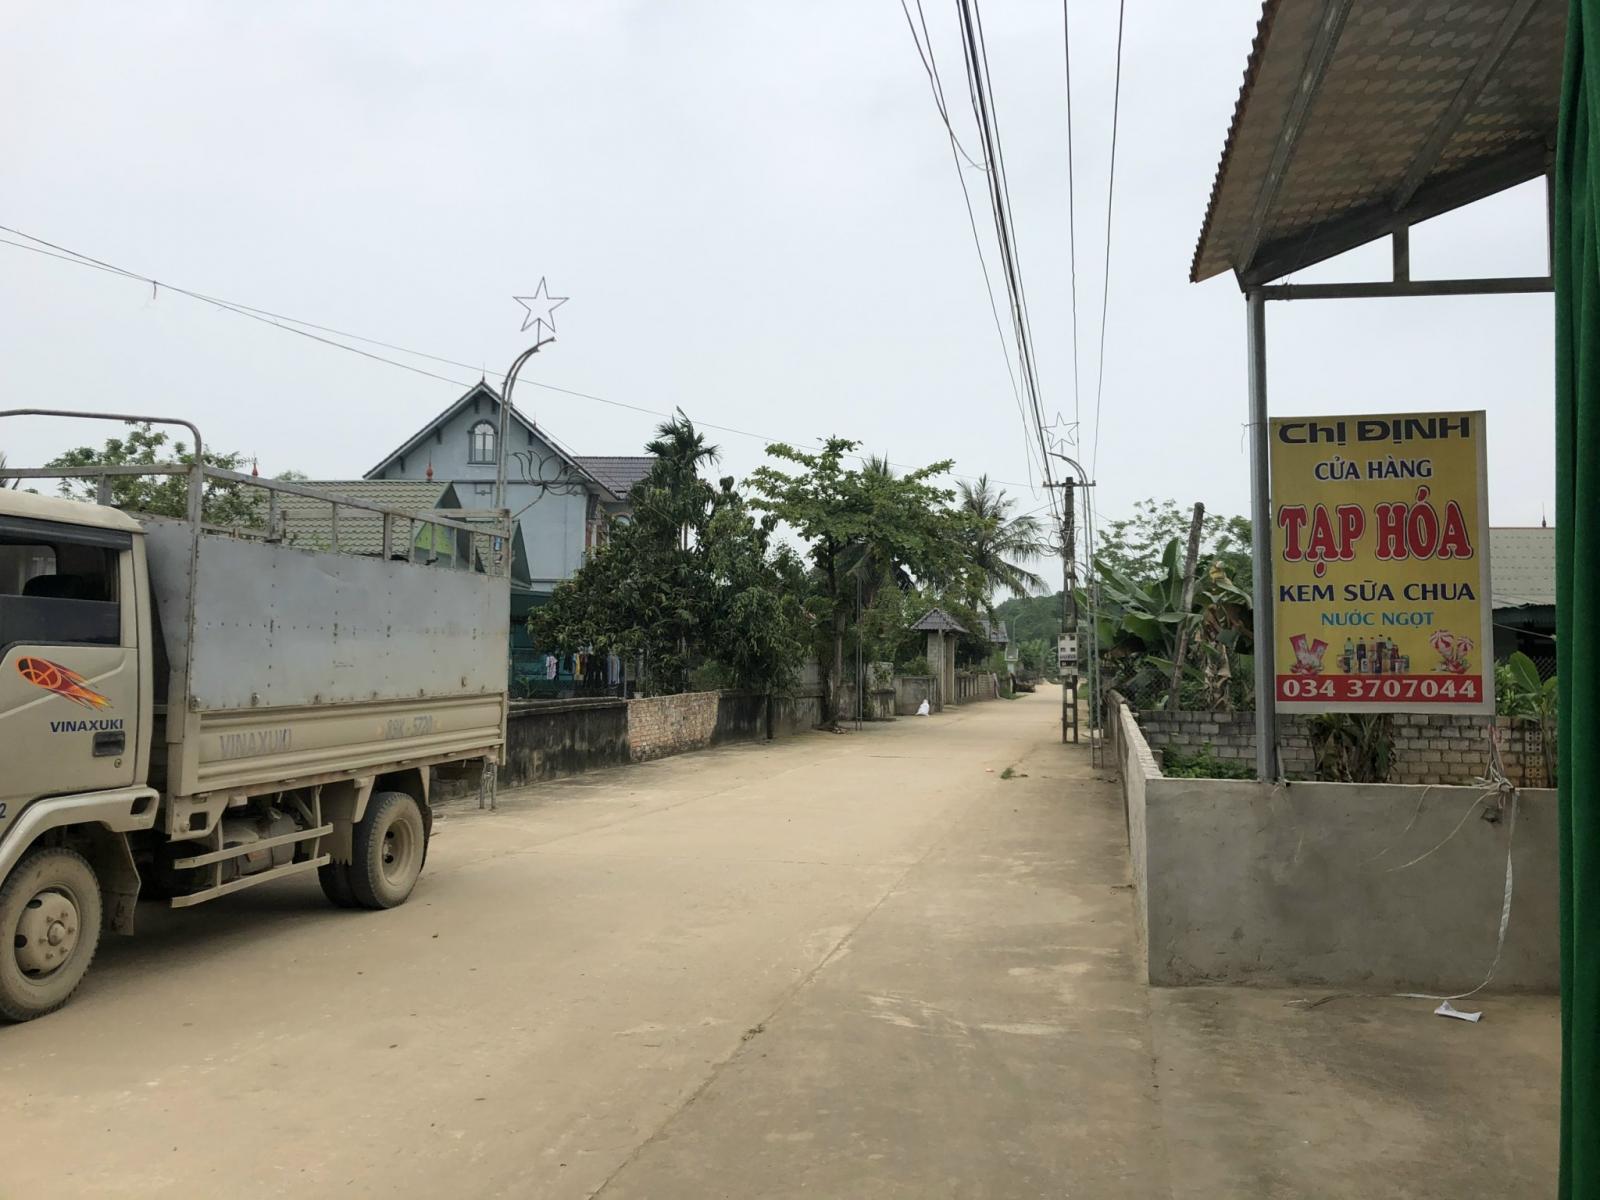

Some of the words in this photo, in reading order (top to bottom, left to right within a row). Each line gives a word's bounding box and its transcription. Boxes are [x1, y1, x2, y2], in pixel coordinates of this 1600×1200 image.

[1357, 416, 1470, 444] ĐỊNH
[1314, 455, 1361, 480] CỬA
[1367, 455, 1433, 479] HÀNG
[1278, 502, 1366, 578] TẠP
[1374, 485, 1474, 560] HÓA
[1279, 584, 1335, 602] KEM
[1343, 580, 1395, 601] SỮA
[1403, 583, 1476, 601] CHUA
[1381, 611, 1435, 629] NGỌT
[1282, 678, 1336, 698] 034
[1346, 679, 1477, 698] 3707044
[50, 718, 124, 733] VINAXUKI
